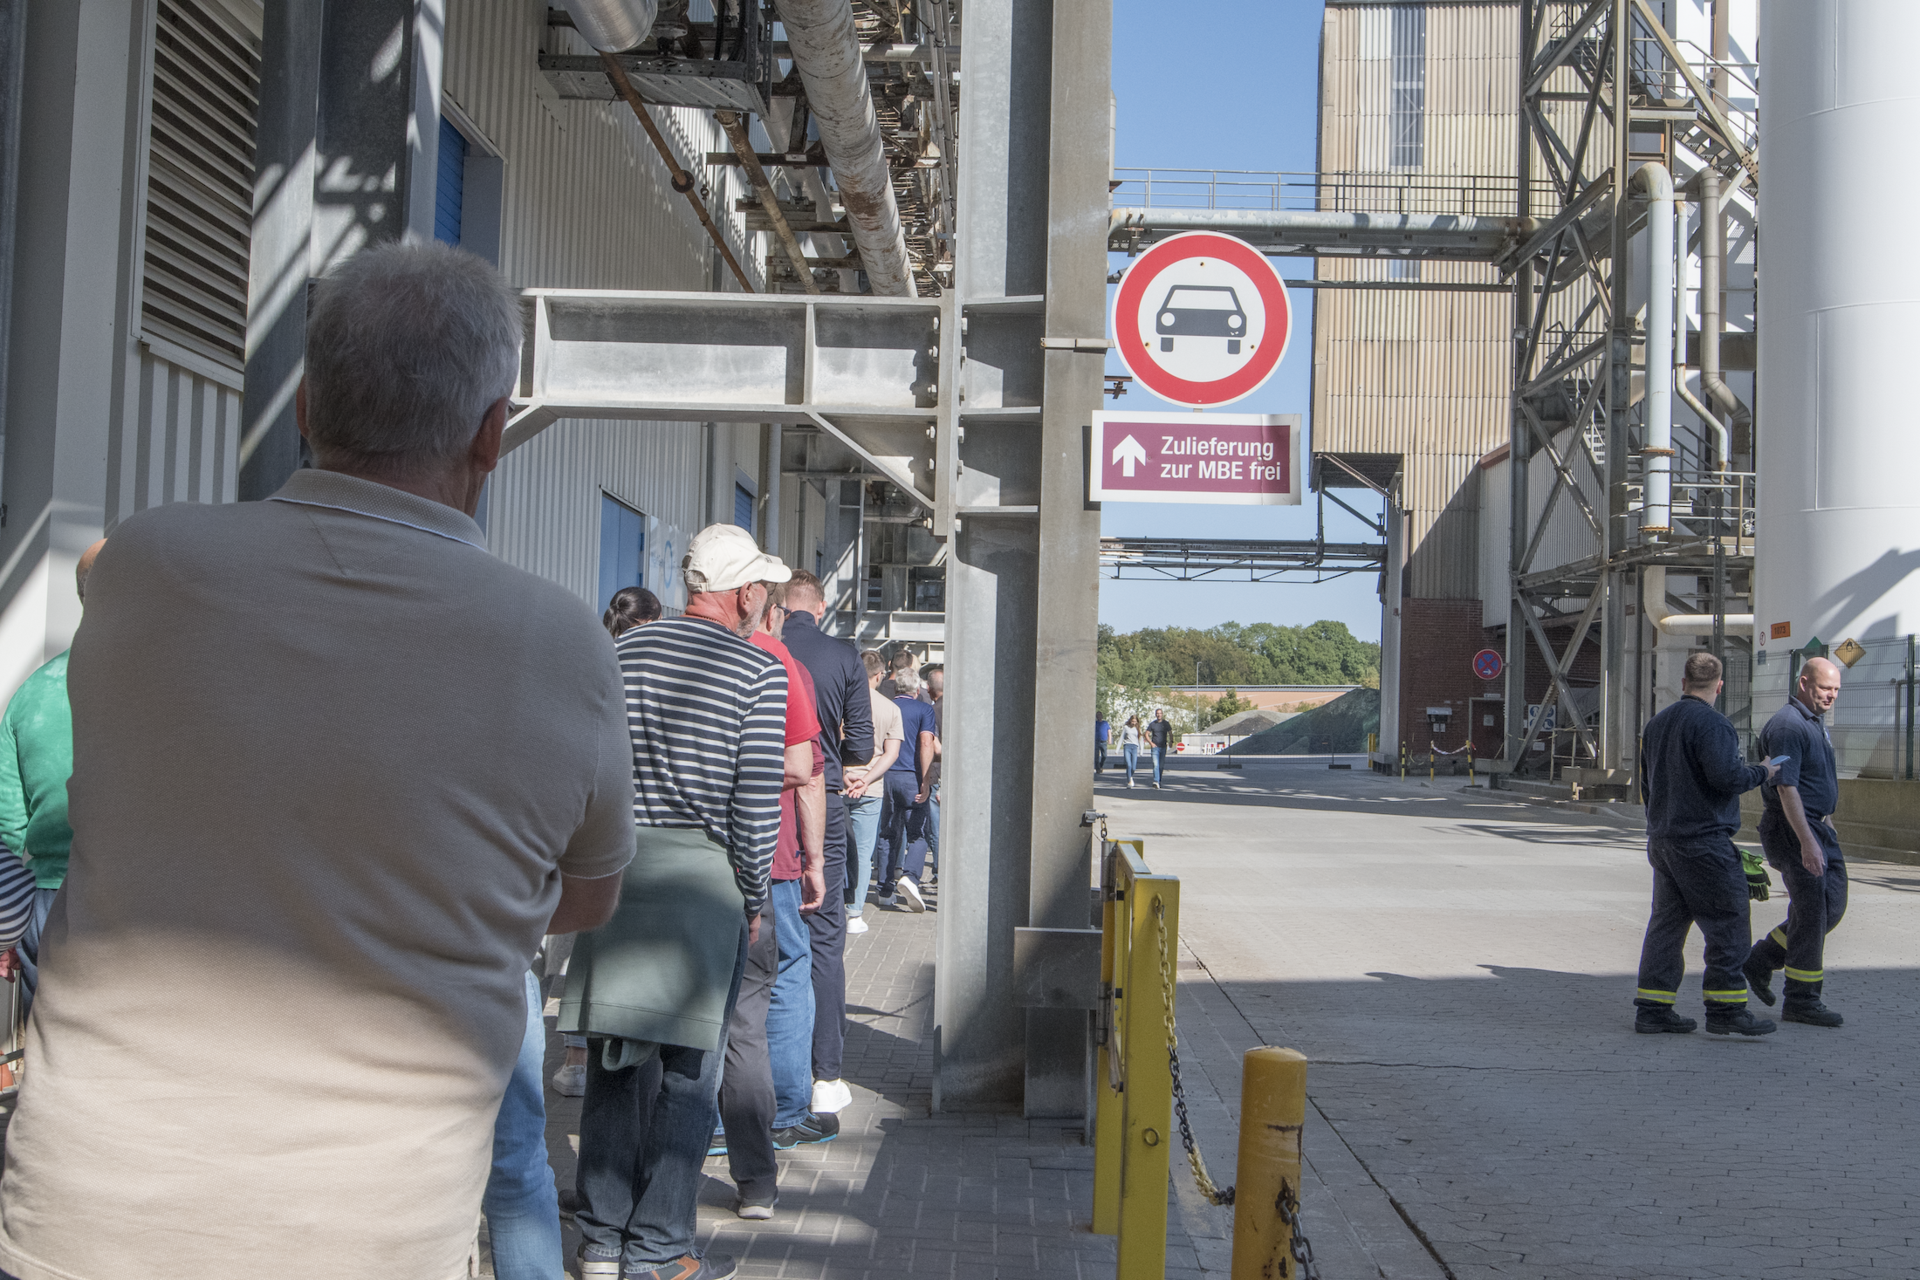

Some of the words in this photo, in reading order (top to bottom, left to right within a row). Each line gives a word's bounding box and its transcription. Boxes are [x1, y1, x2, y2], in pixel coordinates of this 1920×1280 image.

[1160, 436, 1274, 461] Zulieferung
[1160, 463, 1192, 479] zur
[1198, 460, 1243, 480] MBE
[1249, 461, 1281, 481] frei
